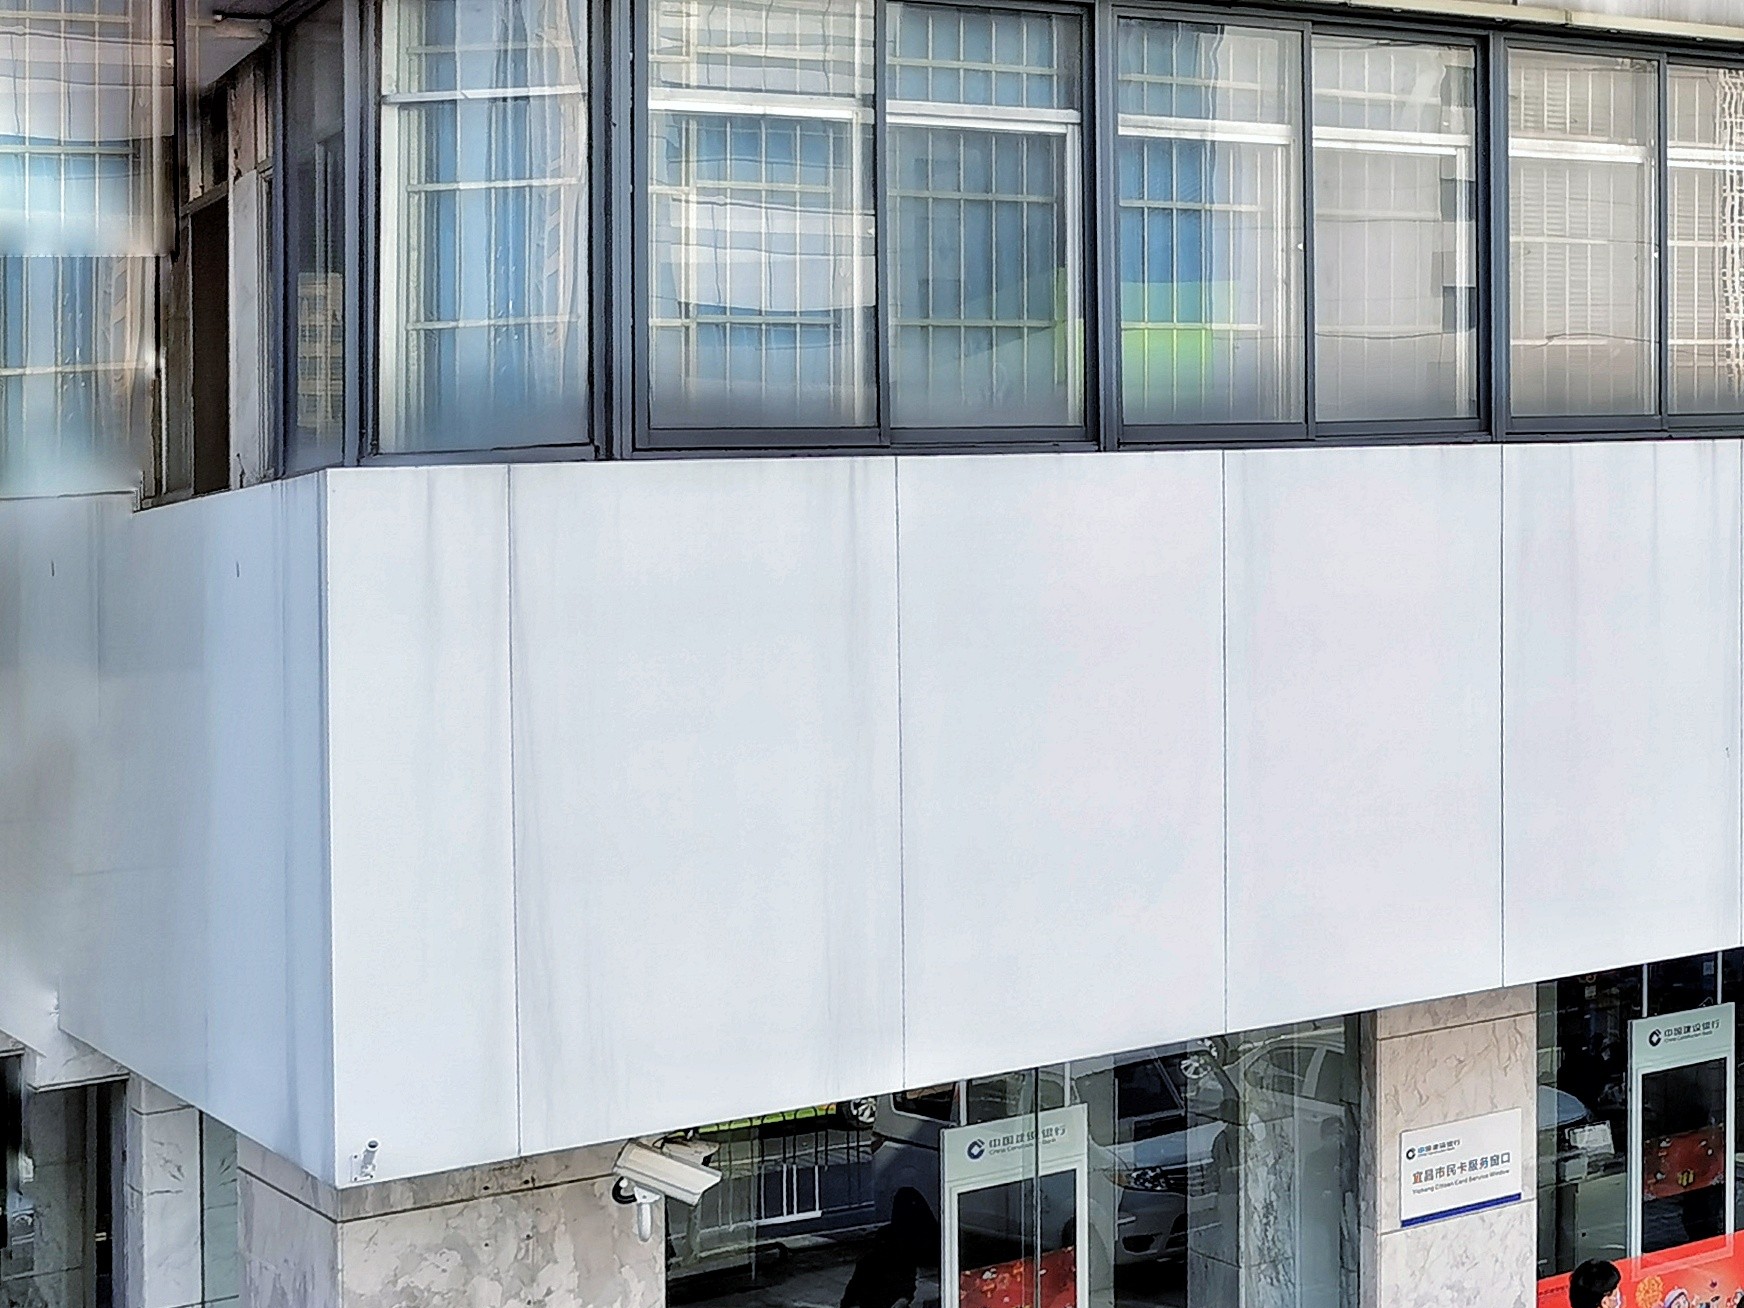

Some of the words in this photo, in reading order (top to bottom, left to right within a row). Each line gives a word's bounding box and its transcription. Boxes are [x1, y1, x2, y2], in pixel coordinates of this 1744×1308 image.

[1412, 1152, 1511, 1184] 宜昌市民卡服务窗口
